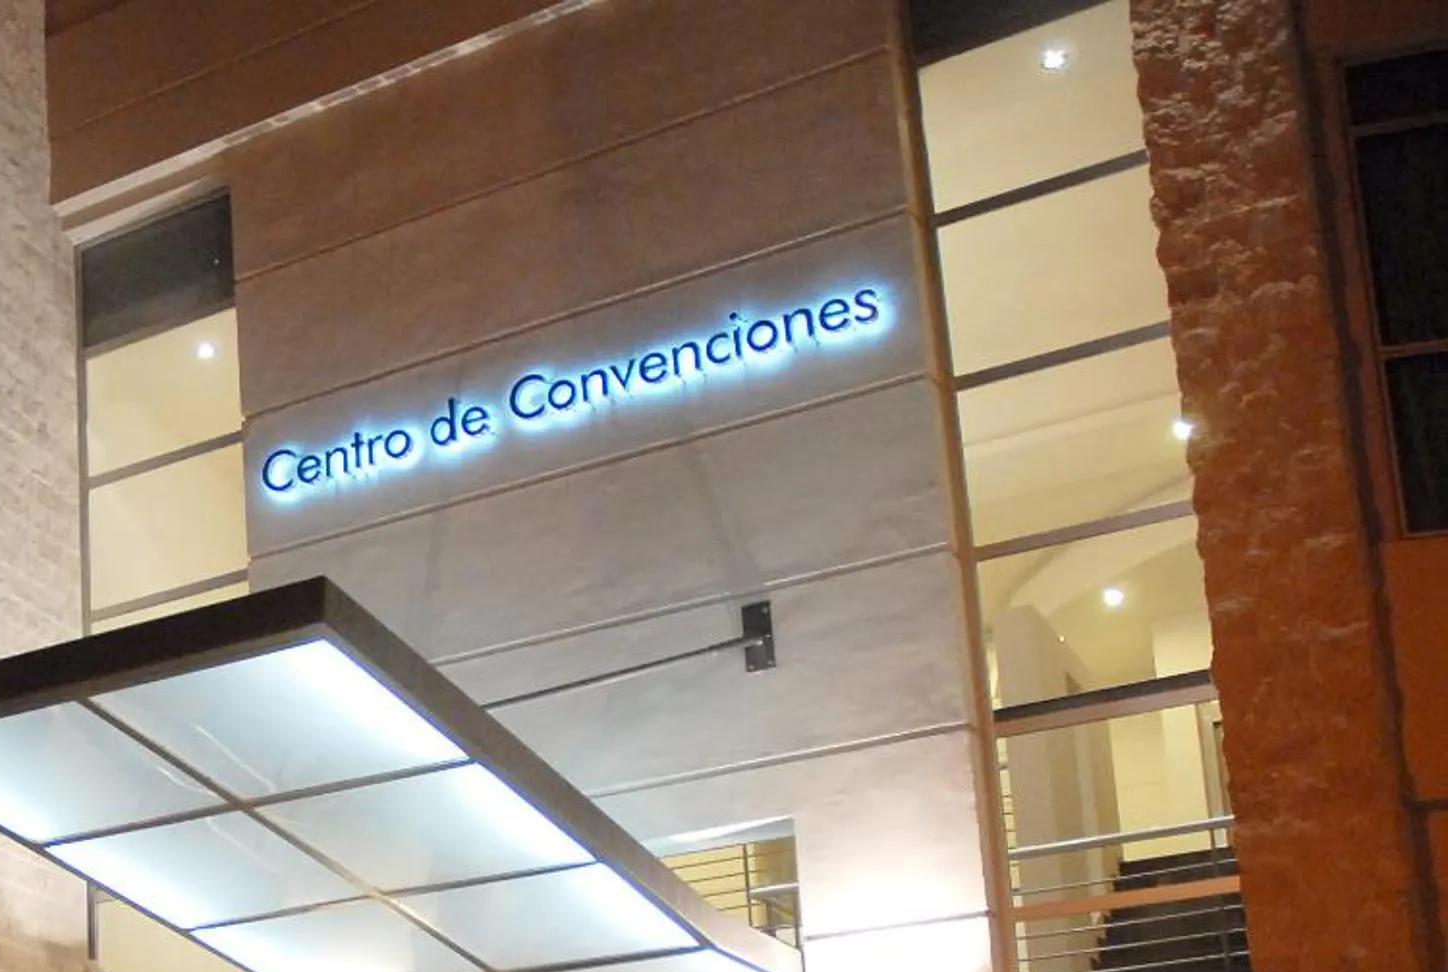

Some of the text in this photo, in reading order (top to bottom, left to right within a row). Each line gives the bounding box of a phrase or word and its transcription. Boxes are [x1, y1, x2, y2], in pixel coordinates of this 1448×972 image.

[261, 287, 880, 491] Centro de Convenciones
